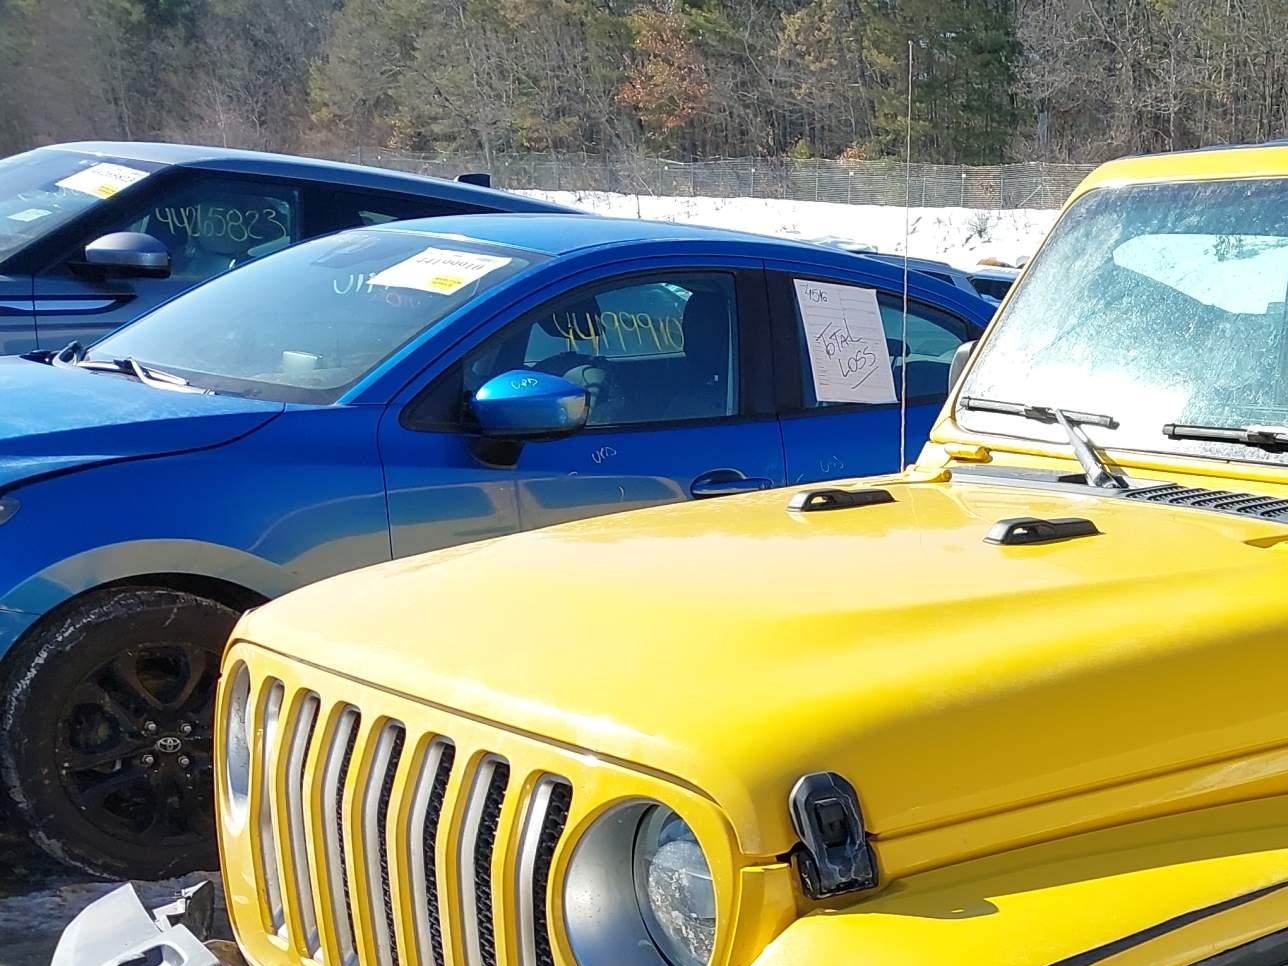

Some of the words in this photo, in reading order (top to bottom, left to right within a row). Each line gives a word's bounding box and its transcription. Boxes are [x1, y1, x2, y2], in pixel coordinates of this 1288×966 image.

[156, 207, 287, 242] 44265823
[552, 311, 686, 352] 44199910
[816, 317, 863, 360] TOTAL
[838, 346, 877, 378] LOSS
